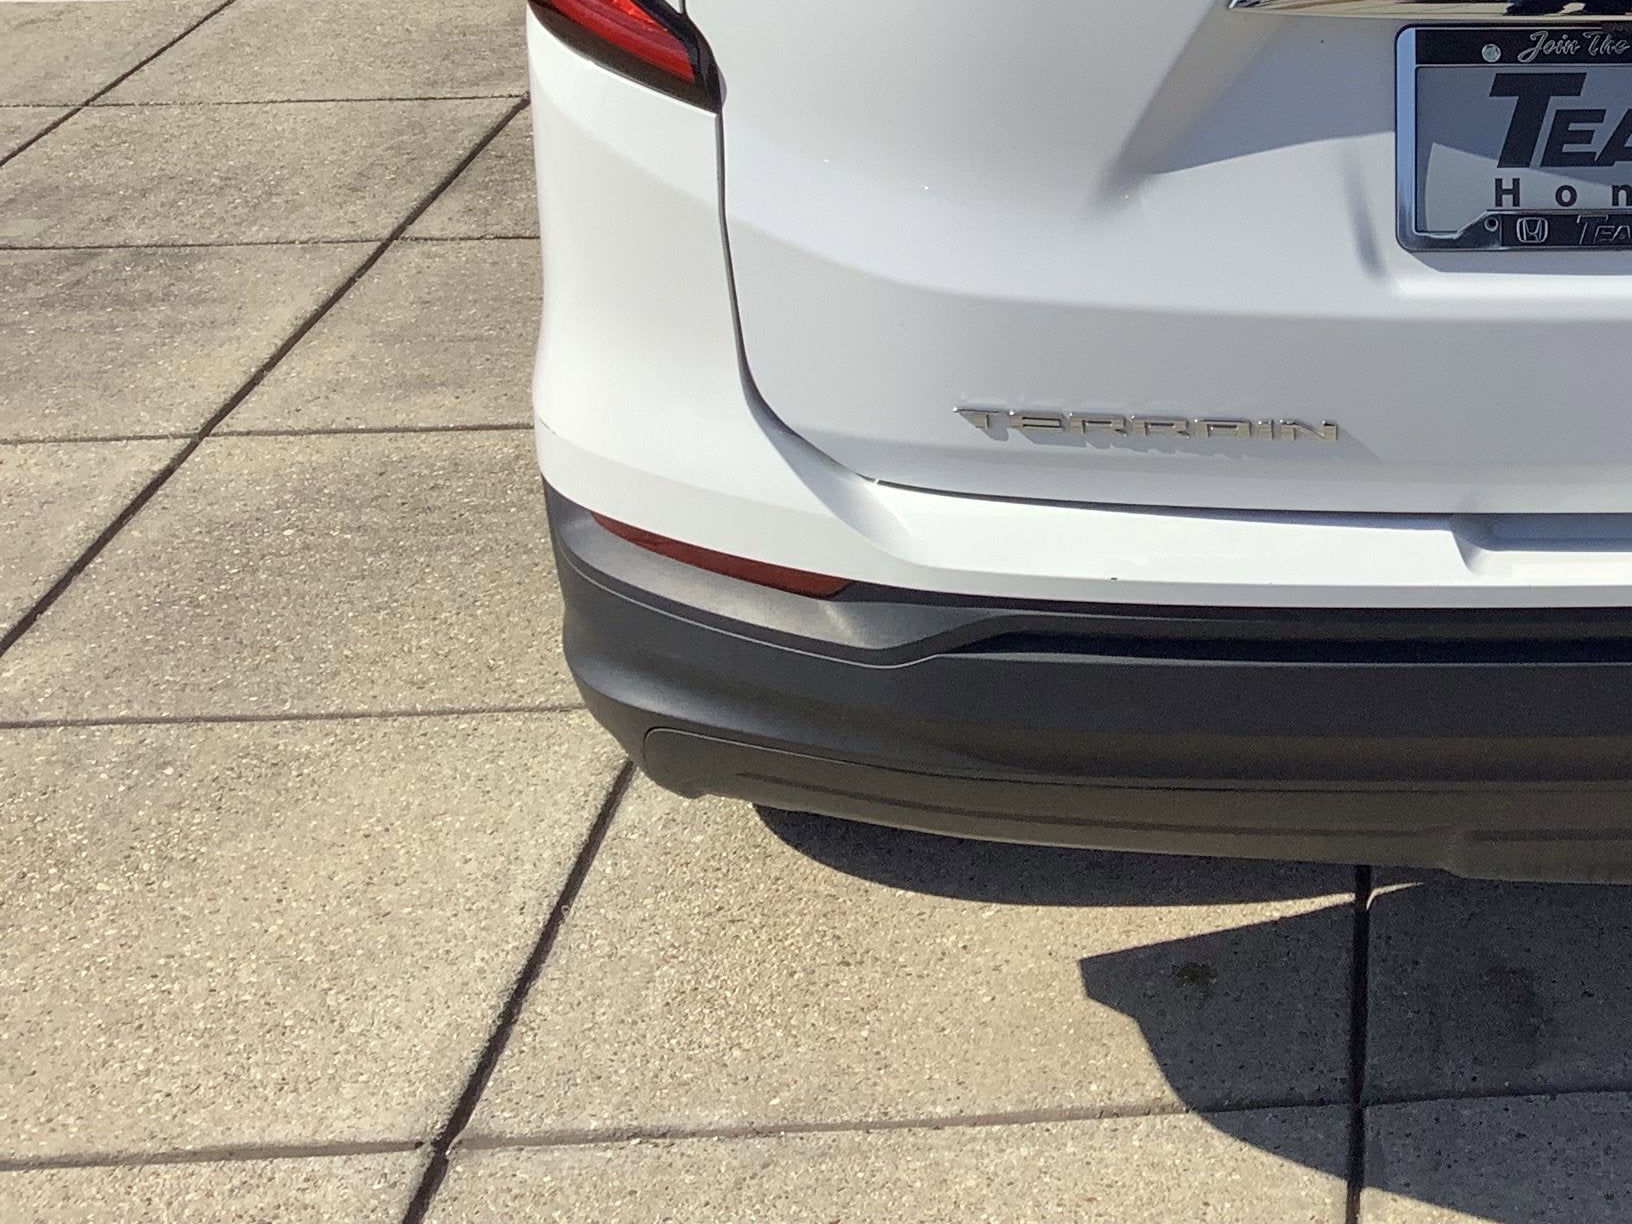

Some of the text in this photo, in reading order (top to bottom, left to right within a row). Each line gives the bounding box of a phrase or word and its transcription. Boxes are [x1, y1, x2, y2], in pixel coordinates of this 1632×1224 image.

[1517, 31, 1581, 63] Join
[1583, 30, 1630, 56] The
[953, 406, 1339, 442] TERRAIN
